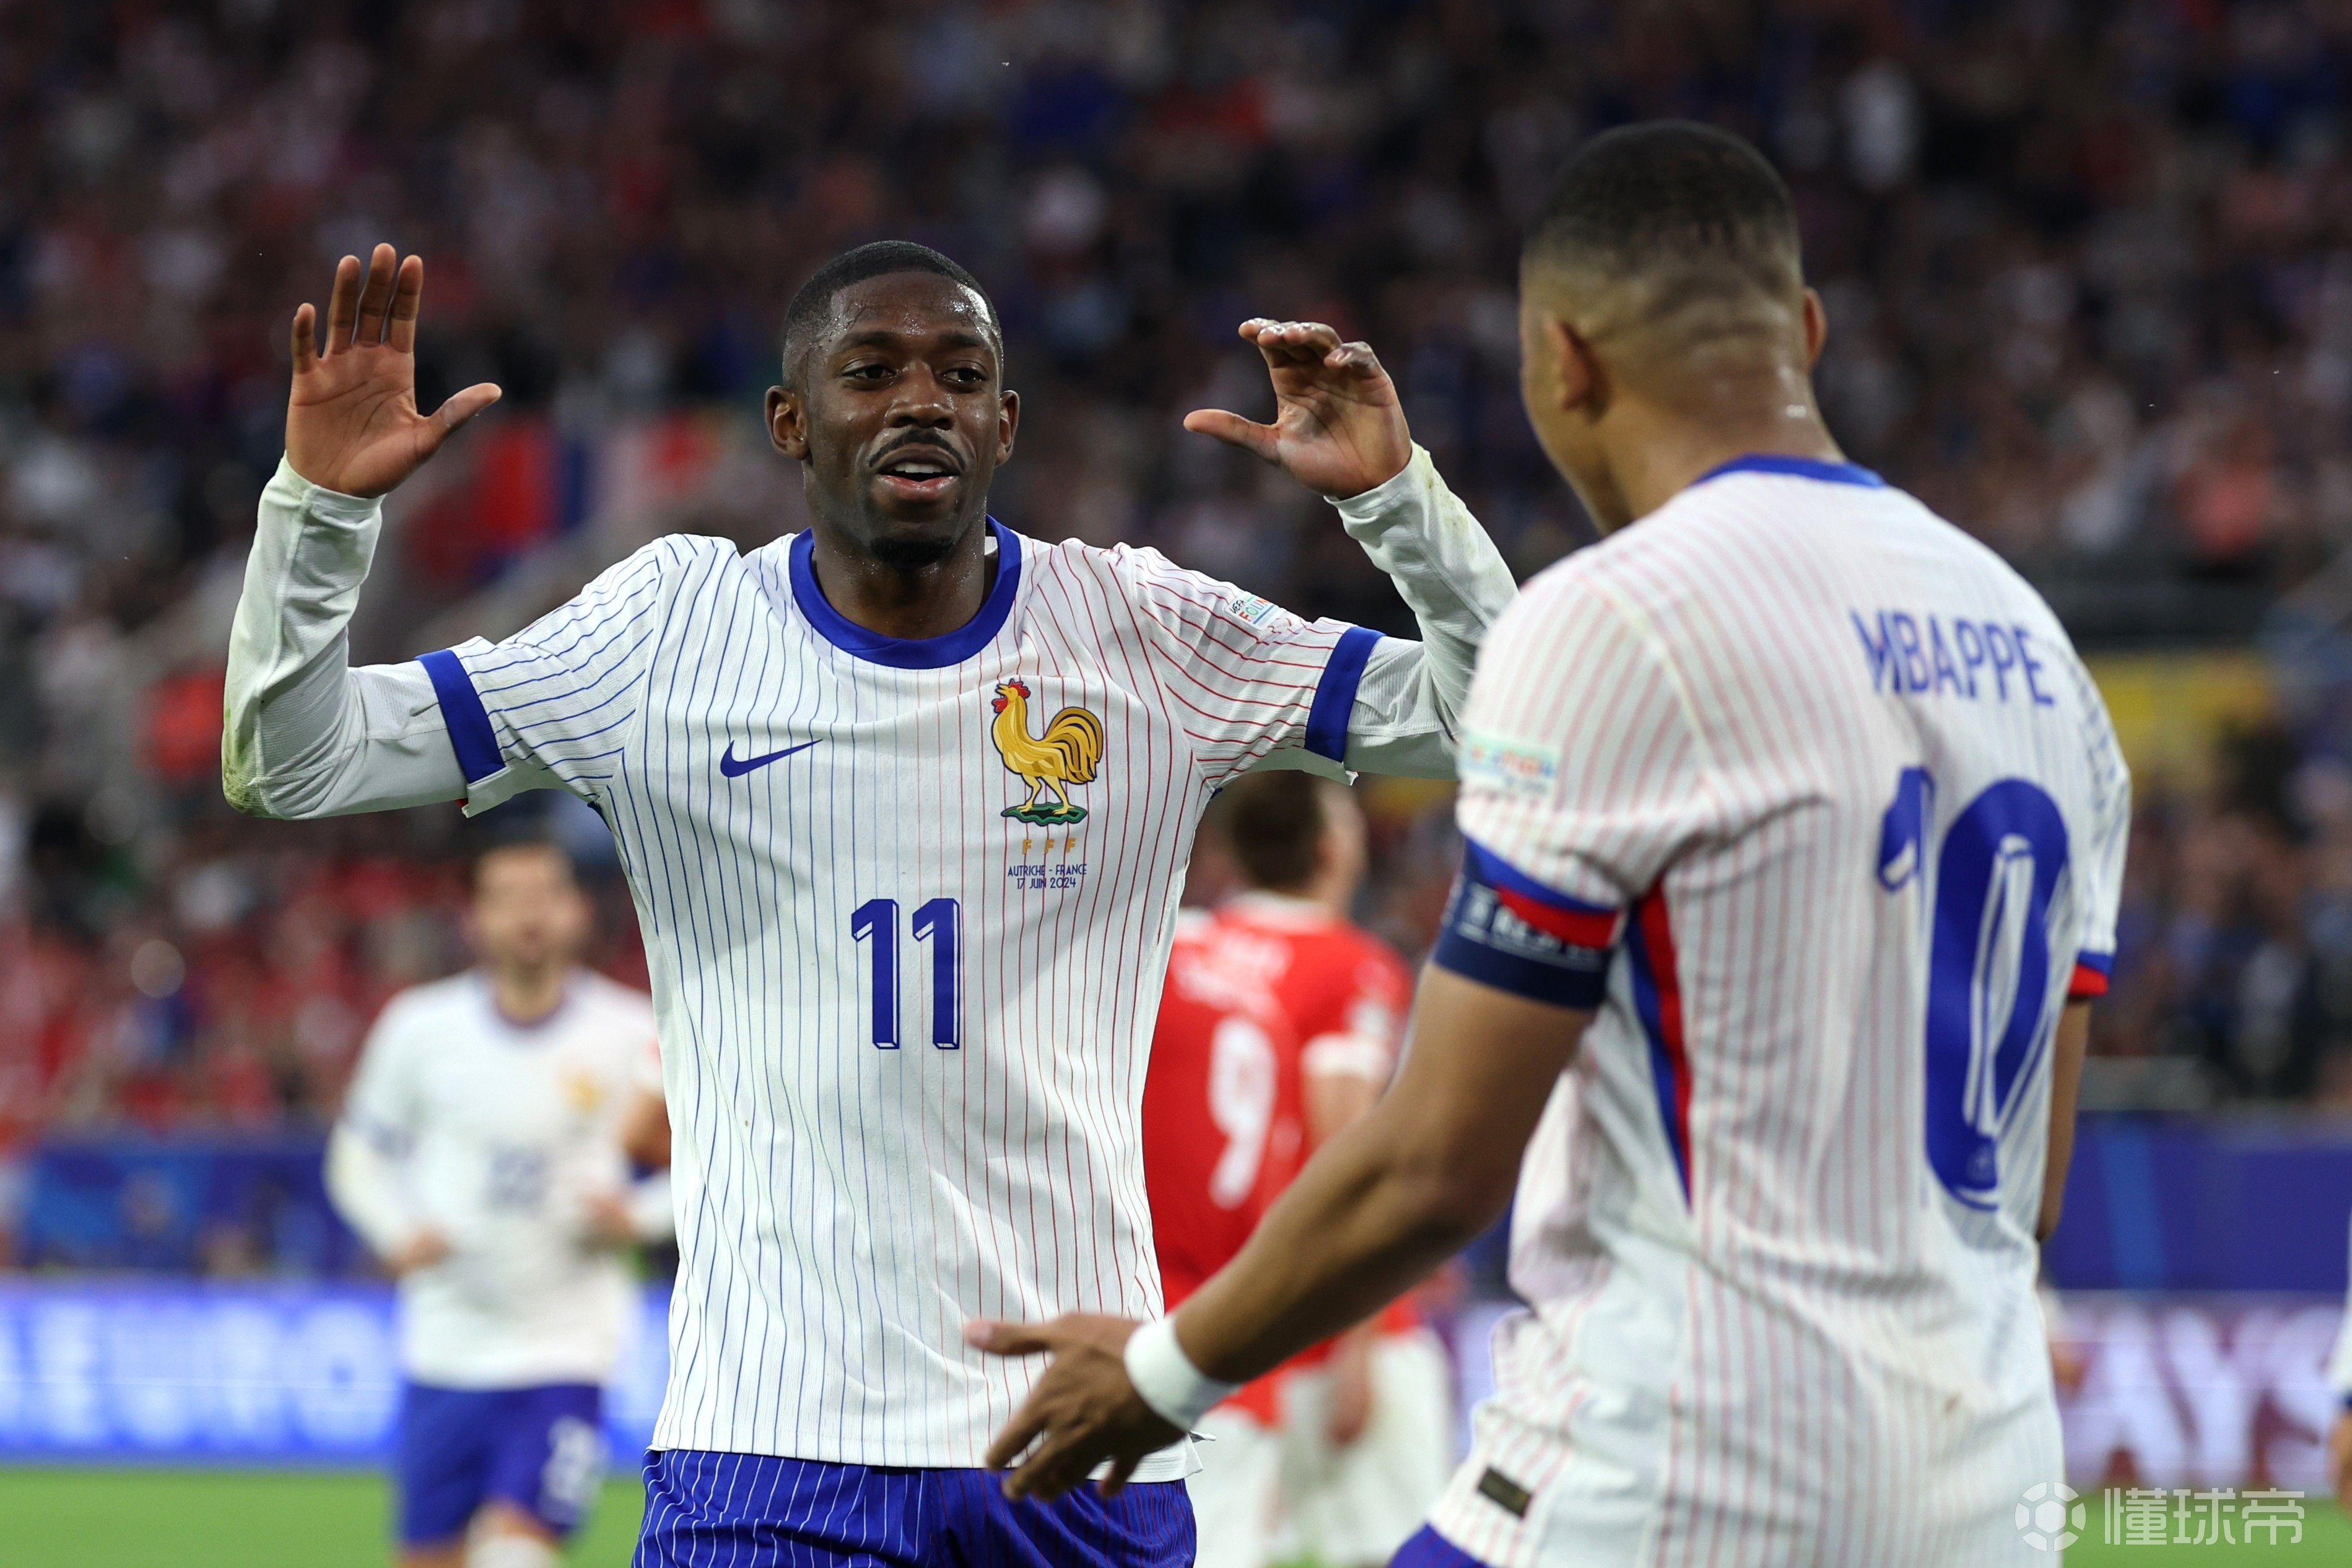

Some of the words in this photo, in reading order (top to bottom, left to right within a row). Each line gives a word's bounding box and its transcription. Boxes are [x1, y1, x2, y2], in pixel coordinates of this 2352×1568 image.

[1229, 599, 1246, 614] UEFA
[1849, 607, 2055, 707] MBAPPE
[1008, 865, 1045, 876] AUTRICHE
[1055, 863, 1087, 876] FRANCE
[1017, 878, 1026, 889] 17
[1029, 878, 1047, 889] JUIN
[1050, 877, 1076, 889] 2024
[852, 898, 960, 1050] 11
[1878, 765, 2067, 1211] 10
[1207, 1013, 1277, 1209] 9
